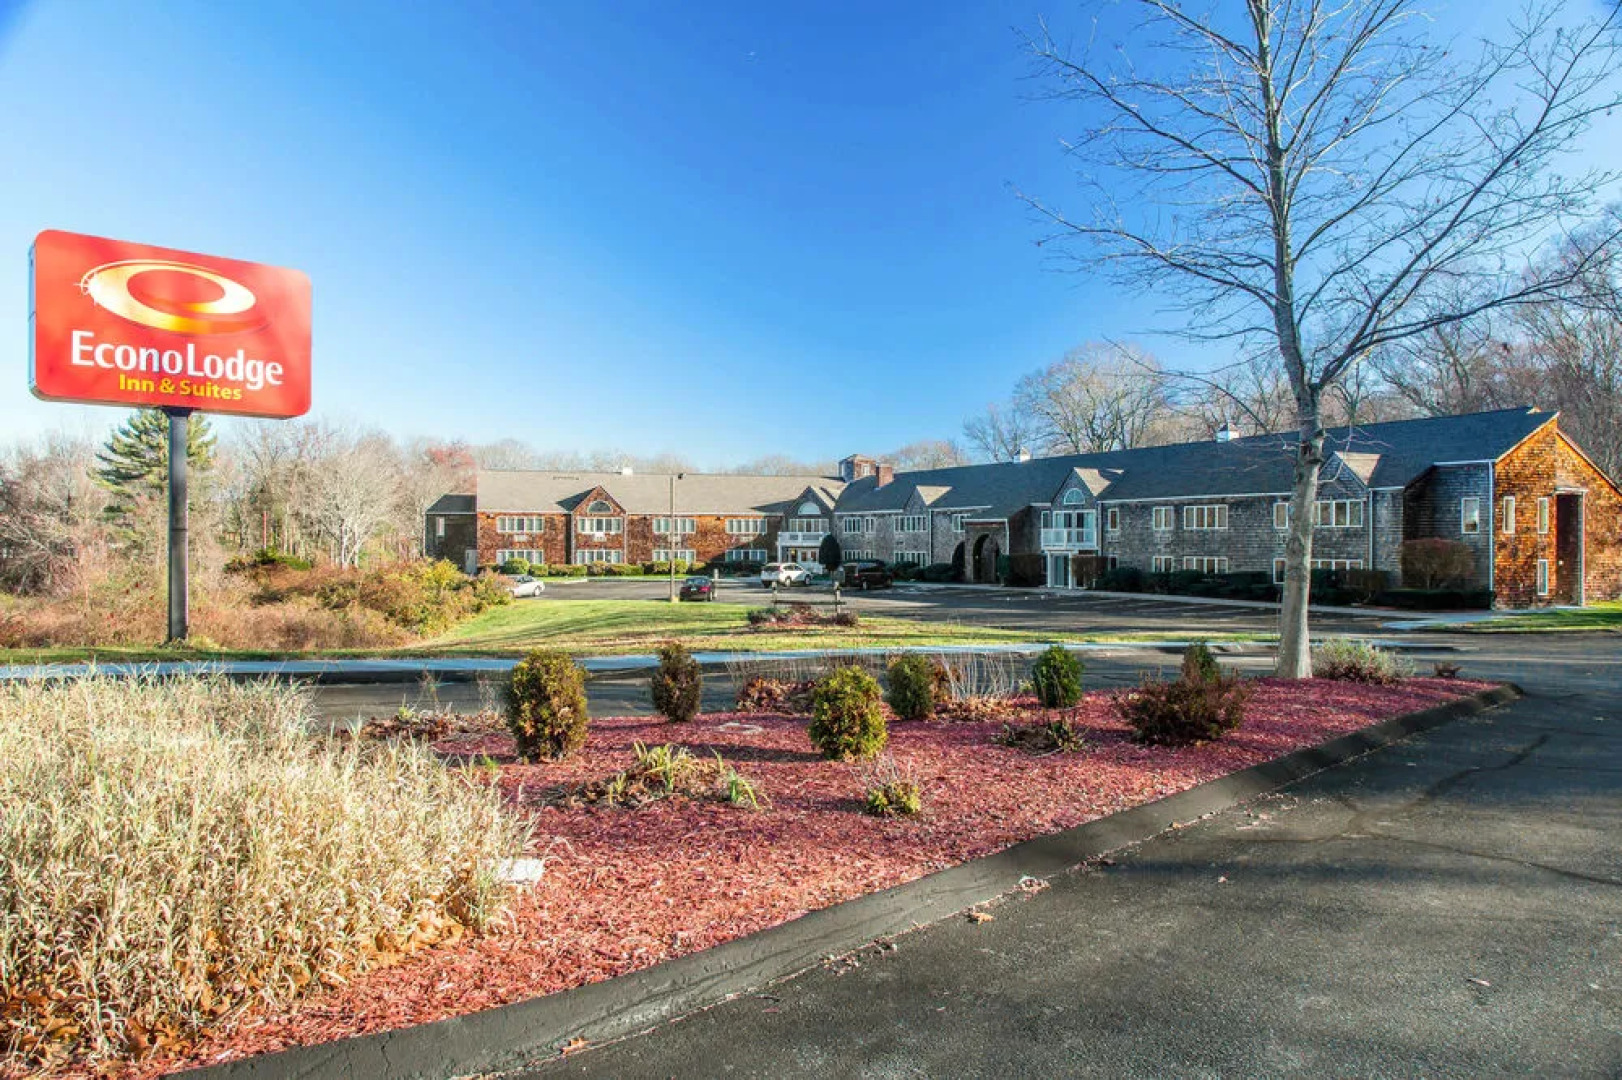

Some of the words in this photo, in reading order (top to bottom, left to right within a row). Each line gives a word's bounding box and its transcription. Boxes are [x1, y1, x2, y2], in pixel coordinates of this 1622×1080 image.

[119, 374, 154, 392] Inn
[159, 377, 175, 395] &
[180, 379, 242, 400] Suites
